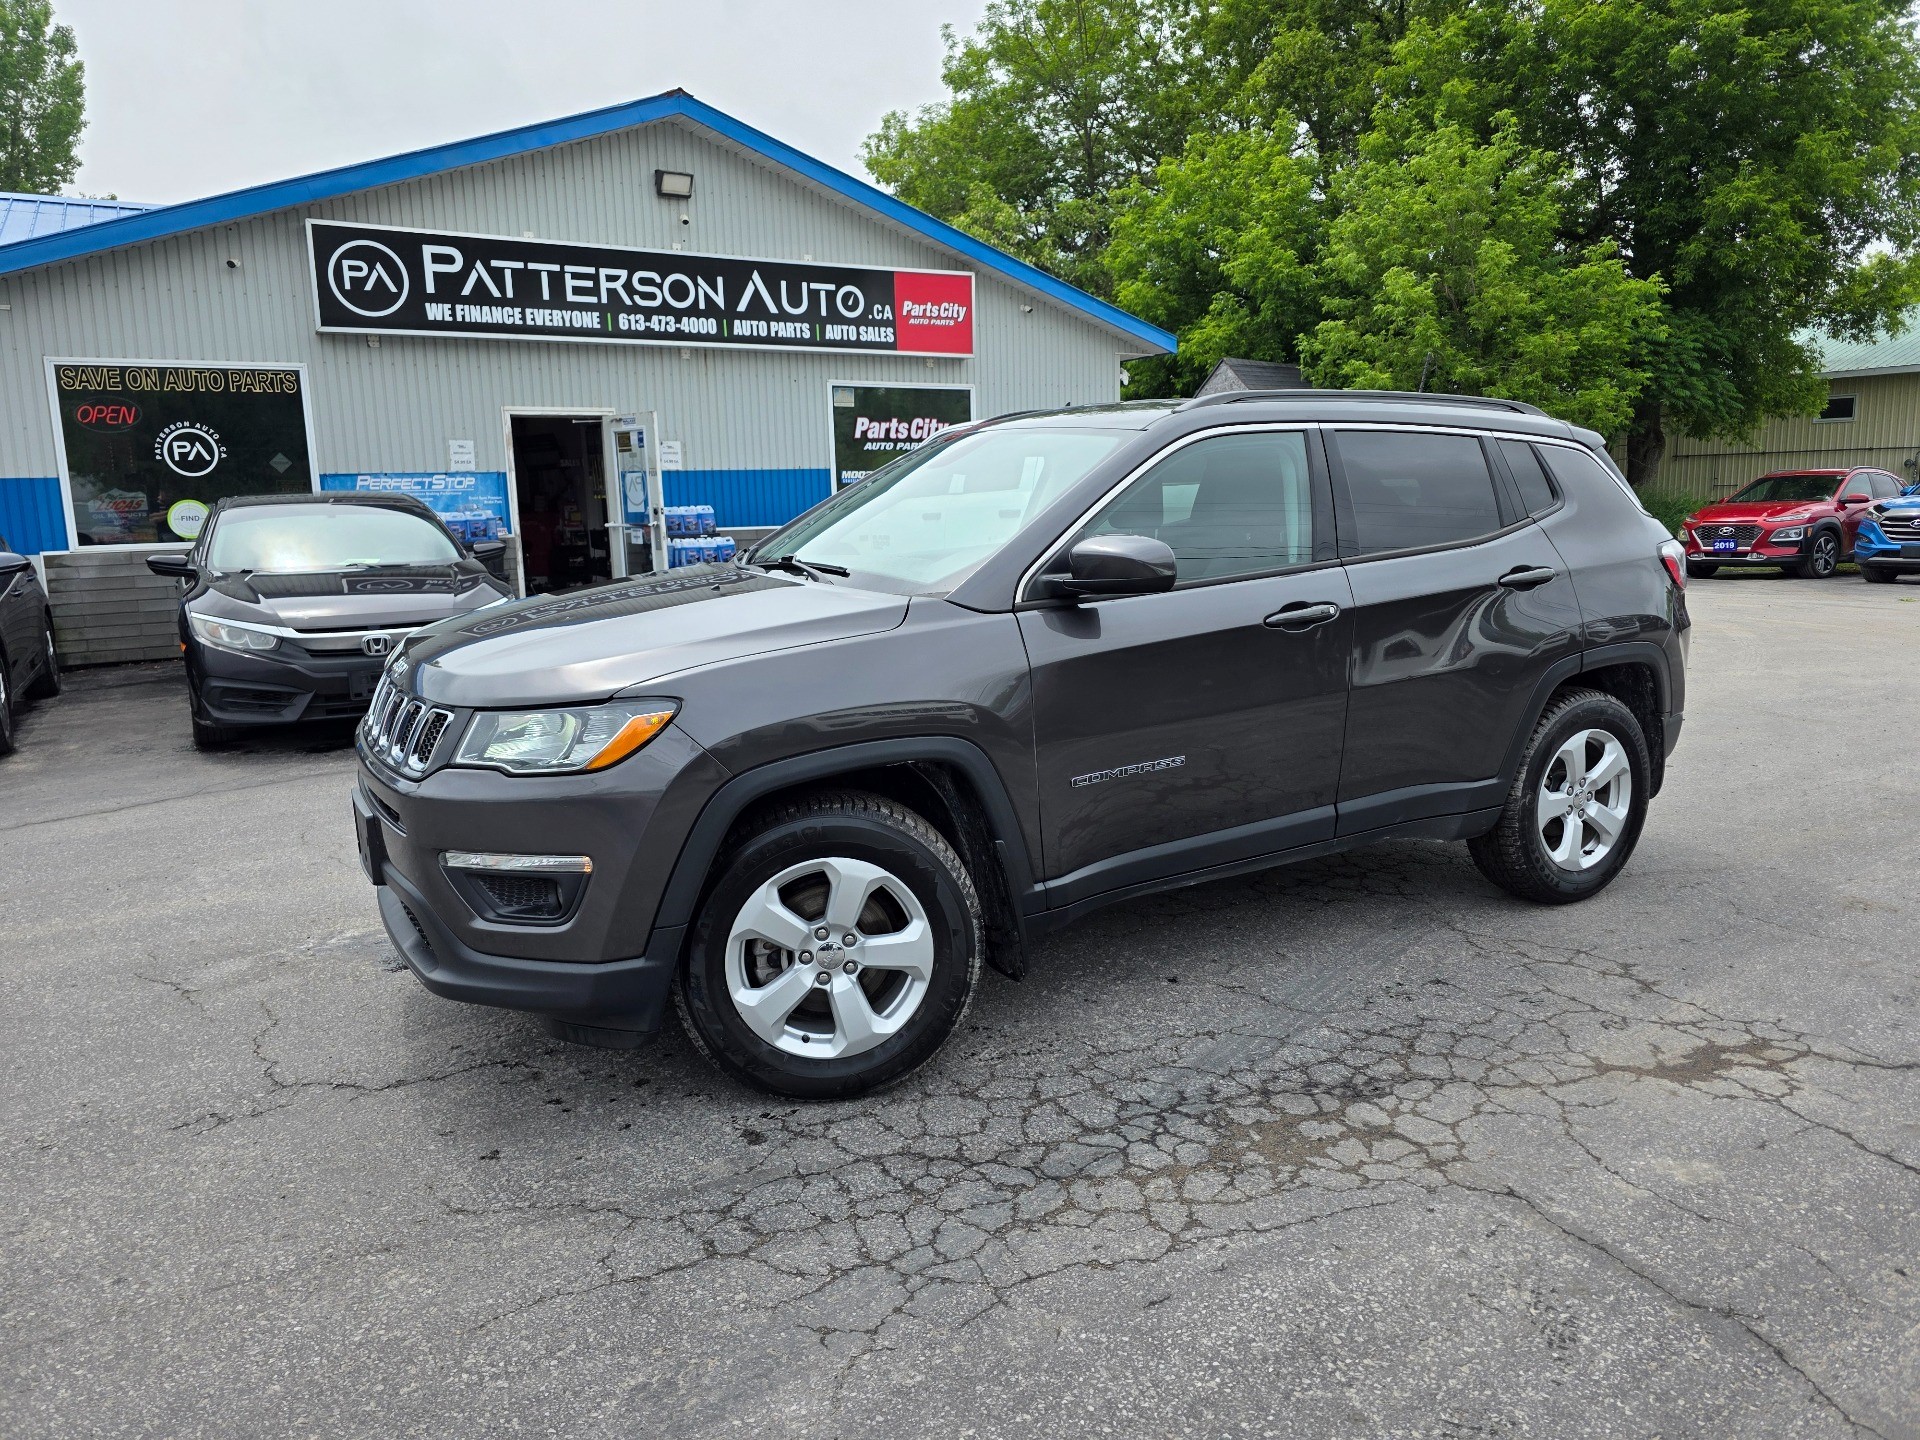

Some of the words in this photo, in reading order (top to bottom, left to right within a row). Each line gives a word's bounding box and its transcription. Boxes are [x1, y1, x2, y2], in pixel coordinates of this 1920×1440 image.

[341, 259, 398, 293] PA
[421, 244, 725, 311] PATTERSON
[424, 302, 453, 321] WE
[455, 304, 523, 325] FINANCE
[525, 308, 601, 329] EVERYONE
[902, 300, 967, 322] PartsCity
[618, 312, 717, 335] 613-473-4000
[733, 319, 768, 337] AUTO
[770, 321, 811, 339] PARTS
[825, 324, 858, 341] AUTO
[859, 325, 894, 343] SALES
[60, 366, 122, 390] SAVE
[125, 368, 160, 391] ON
[164, 369, 224, 392] AUTO
[229, 370, 297, 393] PARTS
[77, 405, 138, 425] OPEN
[854, 416, 949, 440] PartsCit
[154, 420, 190, 460] PATTERSON
[172, 441, 212, 461] PA
[863, 441, 894, 451] AUTO
[896, 442, 922, 451] PAR
[356, 475, 476, 490] PERFECTSTOP
[841, 470, 874, 479] MOO
[1713, 541, 1736, 550] 2019
[1070, 755, 1186, 787] COMPASS
